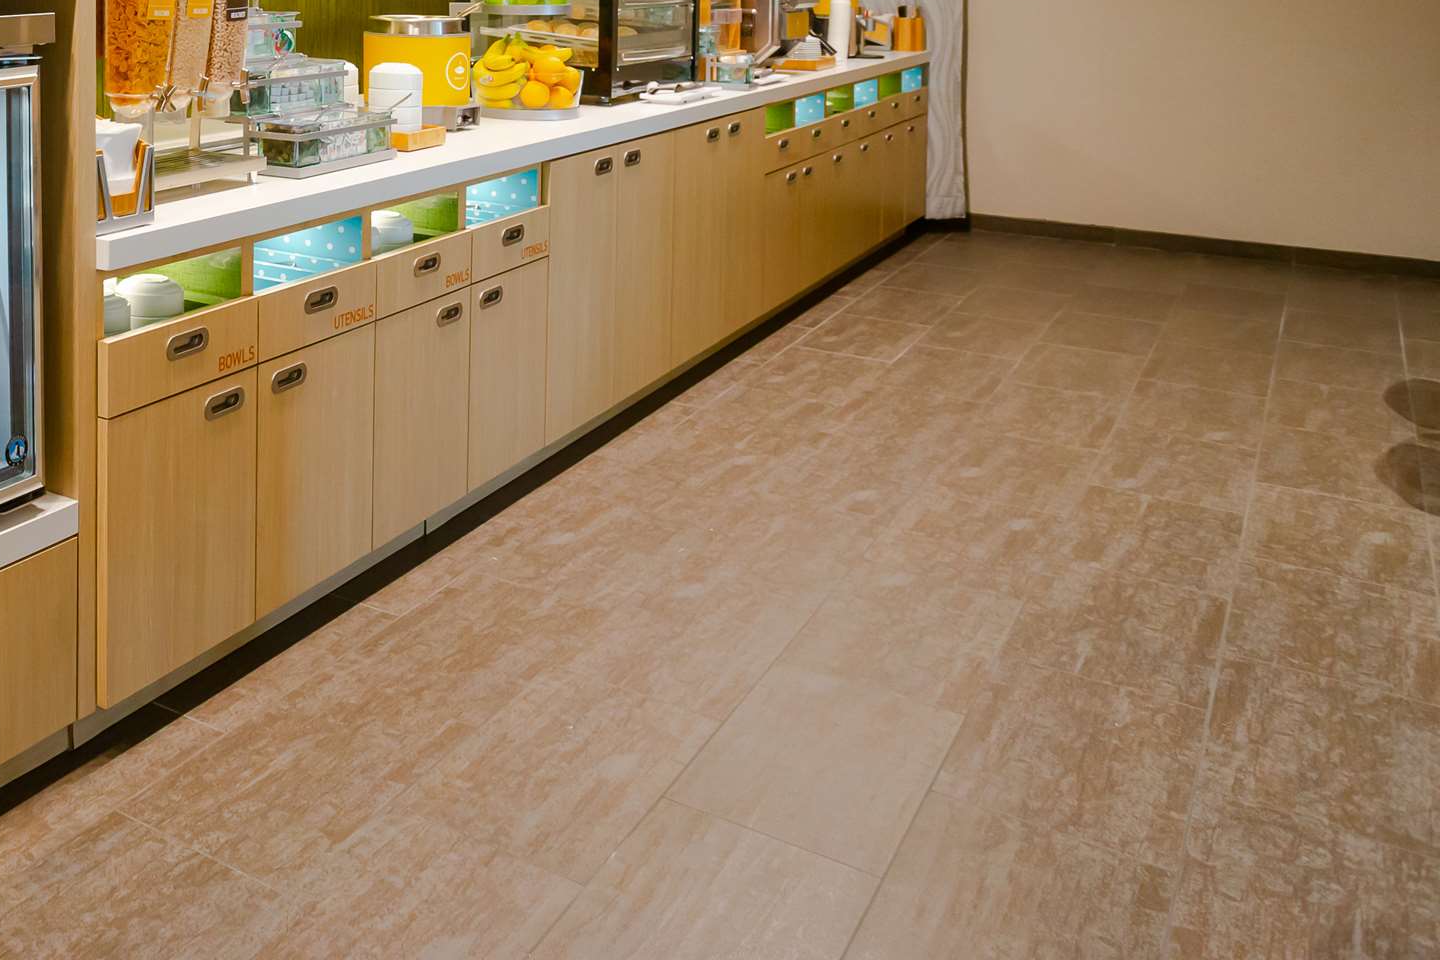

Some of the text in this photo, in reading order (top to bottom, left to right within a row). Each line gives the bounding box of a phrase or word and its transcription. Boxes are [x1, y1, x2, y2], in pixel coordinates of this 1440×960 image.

[522, 240, 549, 258] UTENSILS
[445, 268, 470, 288] BOWLS
[334, 304, 374, 329] UTENSILS
[218, 345, 255, 372] BOWLS
